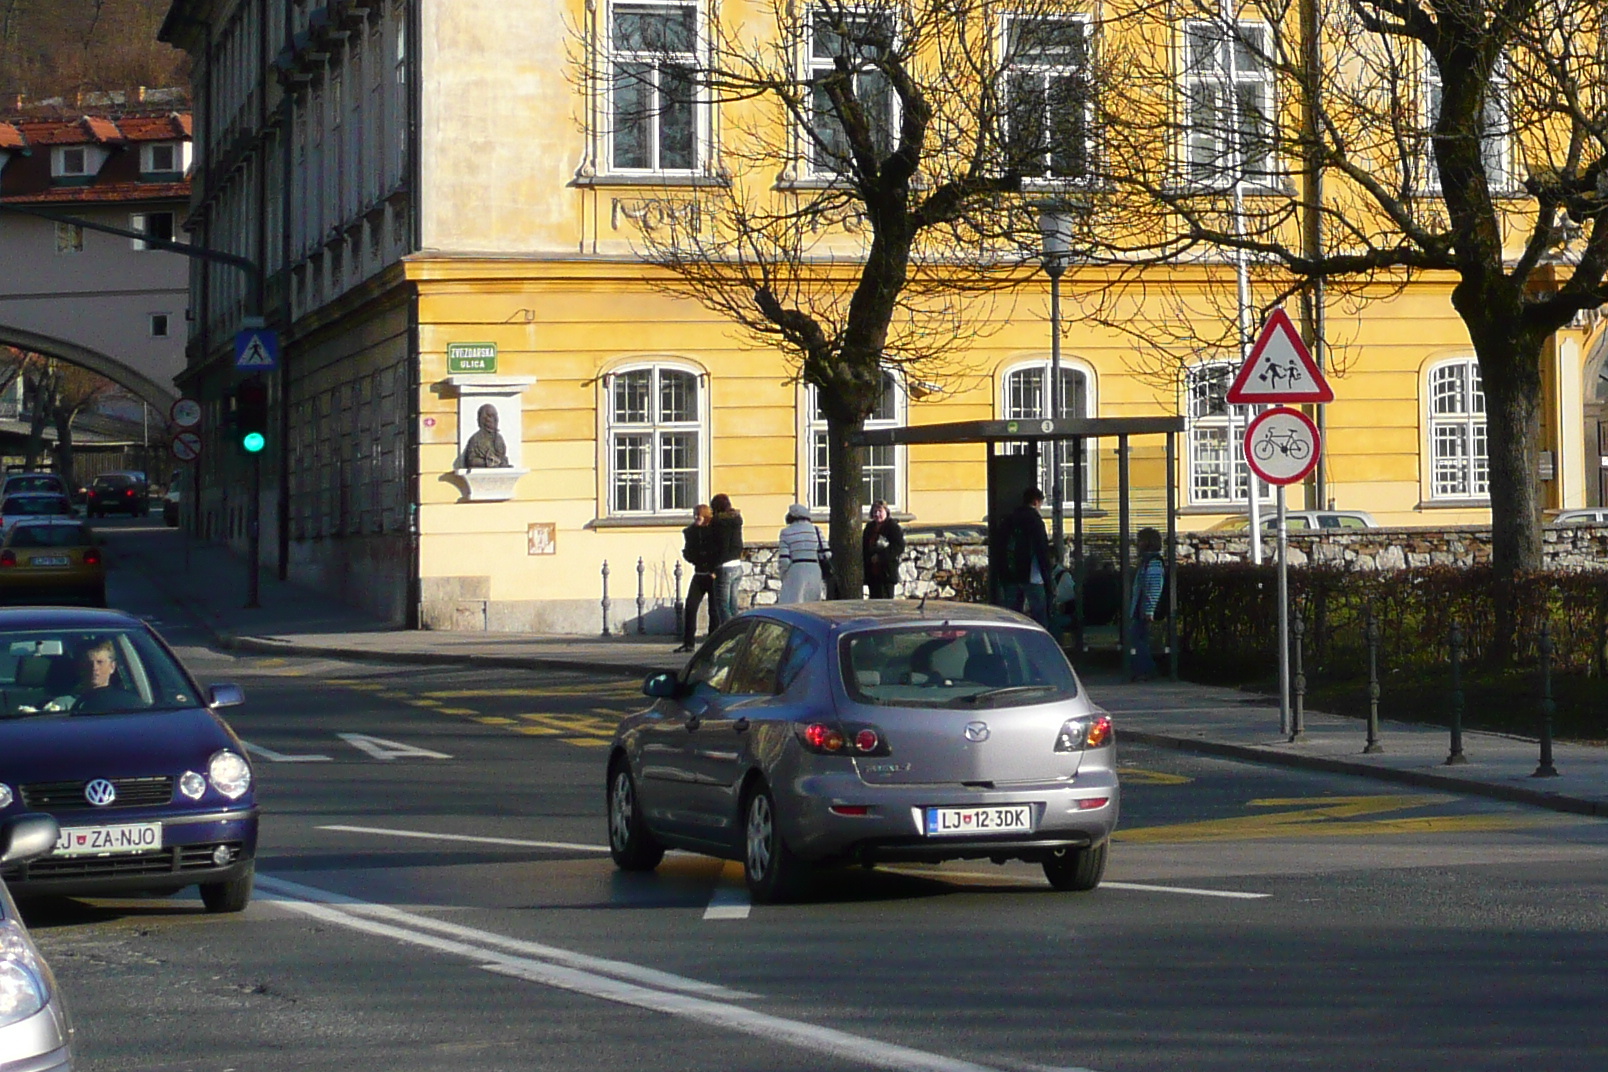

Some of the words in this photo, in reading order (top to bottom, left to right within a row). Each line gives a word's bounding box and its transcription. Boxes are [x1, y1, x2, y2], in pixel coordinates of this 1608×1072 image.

[451, 348, 494, 358] ZVEZDARSKA
[460, 360, 485, 368] ULICA
[942, 811, 961, 829] LJ
